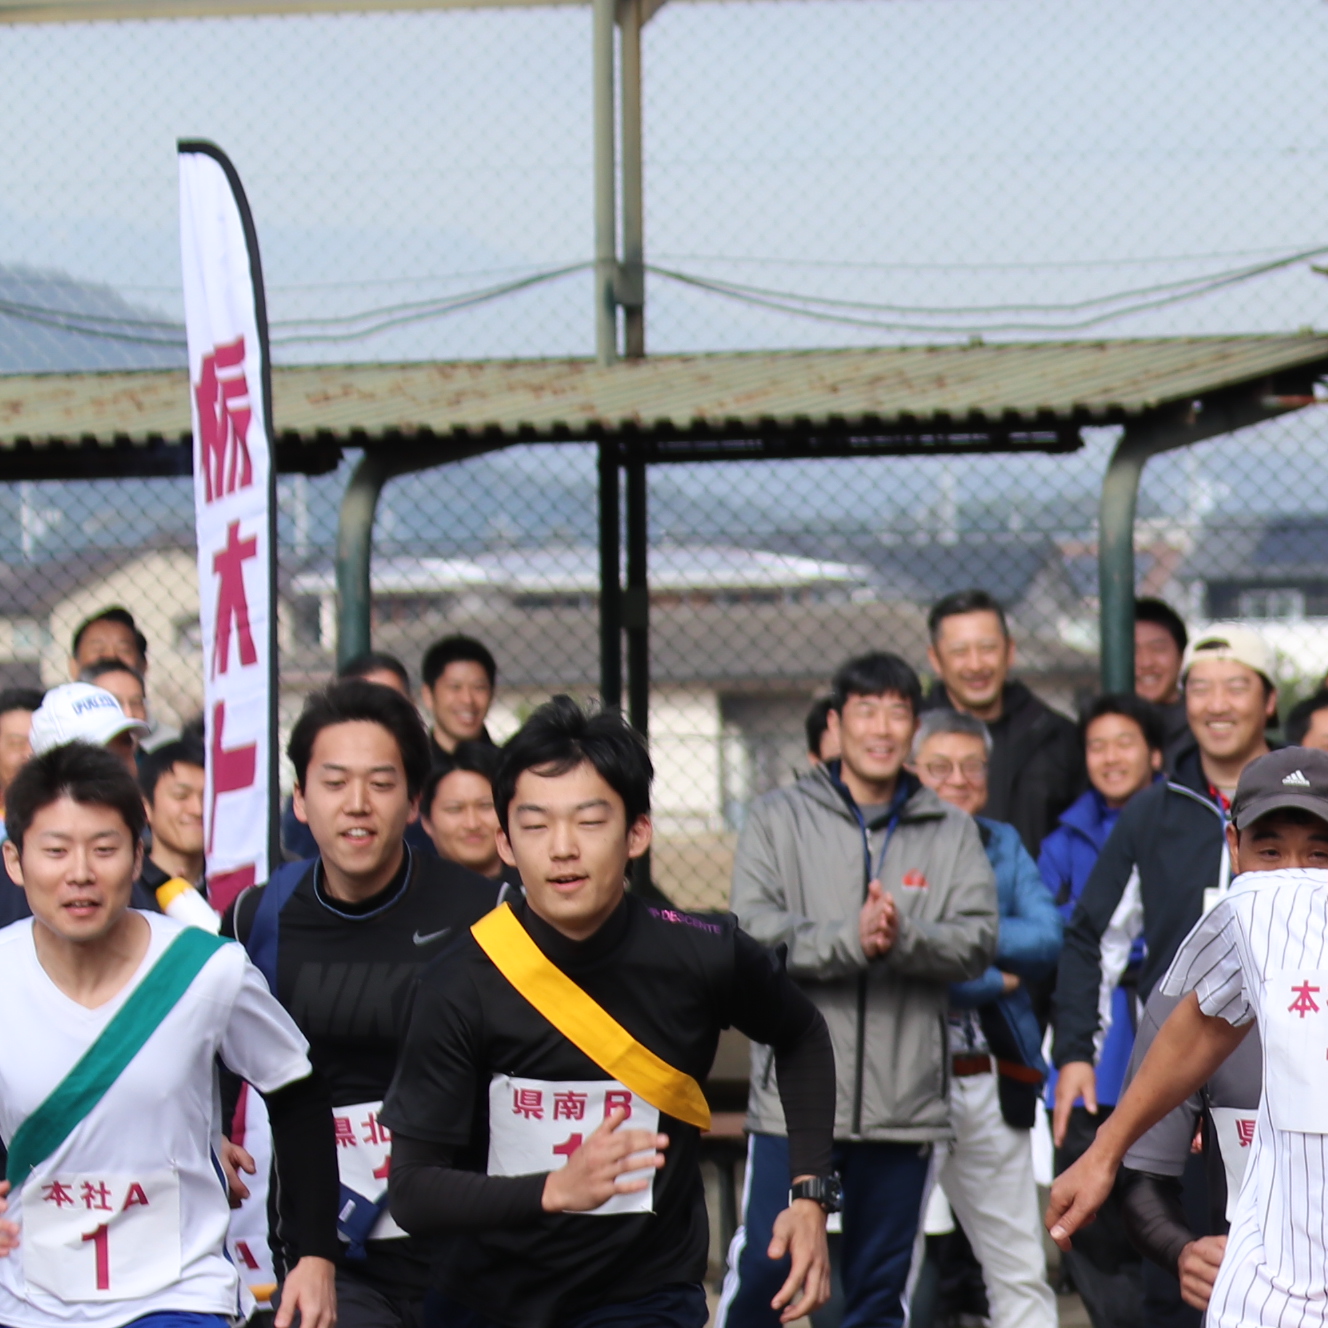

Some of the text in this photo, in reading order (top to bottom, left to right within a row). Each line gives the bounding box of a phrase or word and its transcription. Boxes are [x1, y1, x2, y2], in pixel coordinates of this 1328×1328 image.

[661, 909, 722, 935] DESCENTE
[512, 1088, 633, 1121] 県南B
[41, 1180, 150, 1212] 本社A
[81, 1223, 110, 1290] 1
